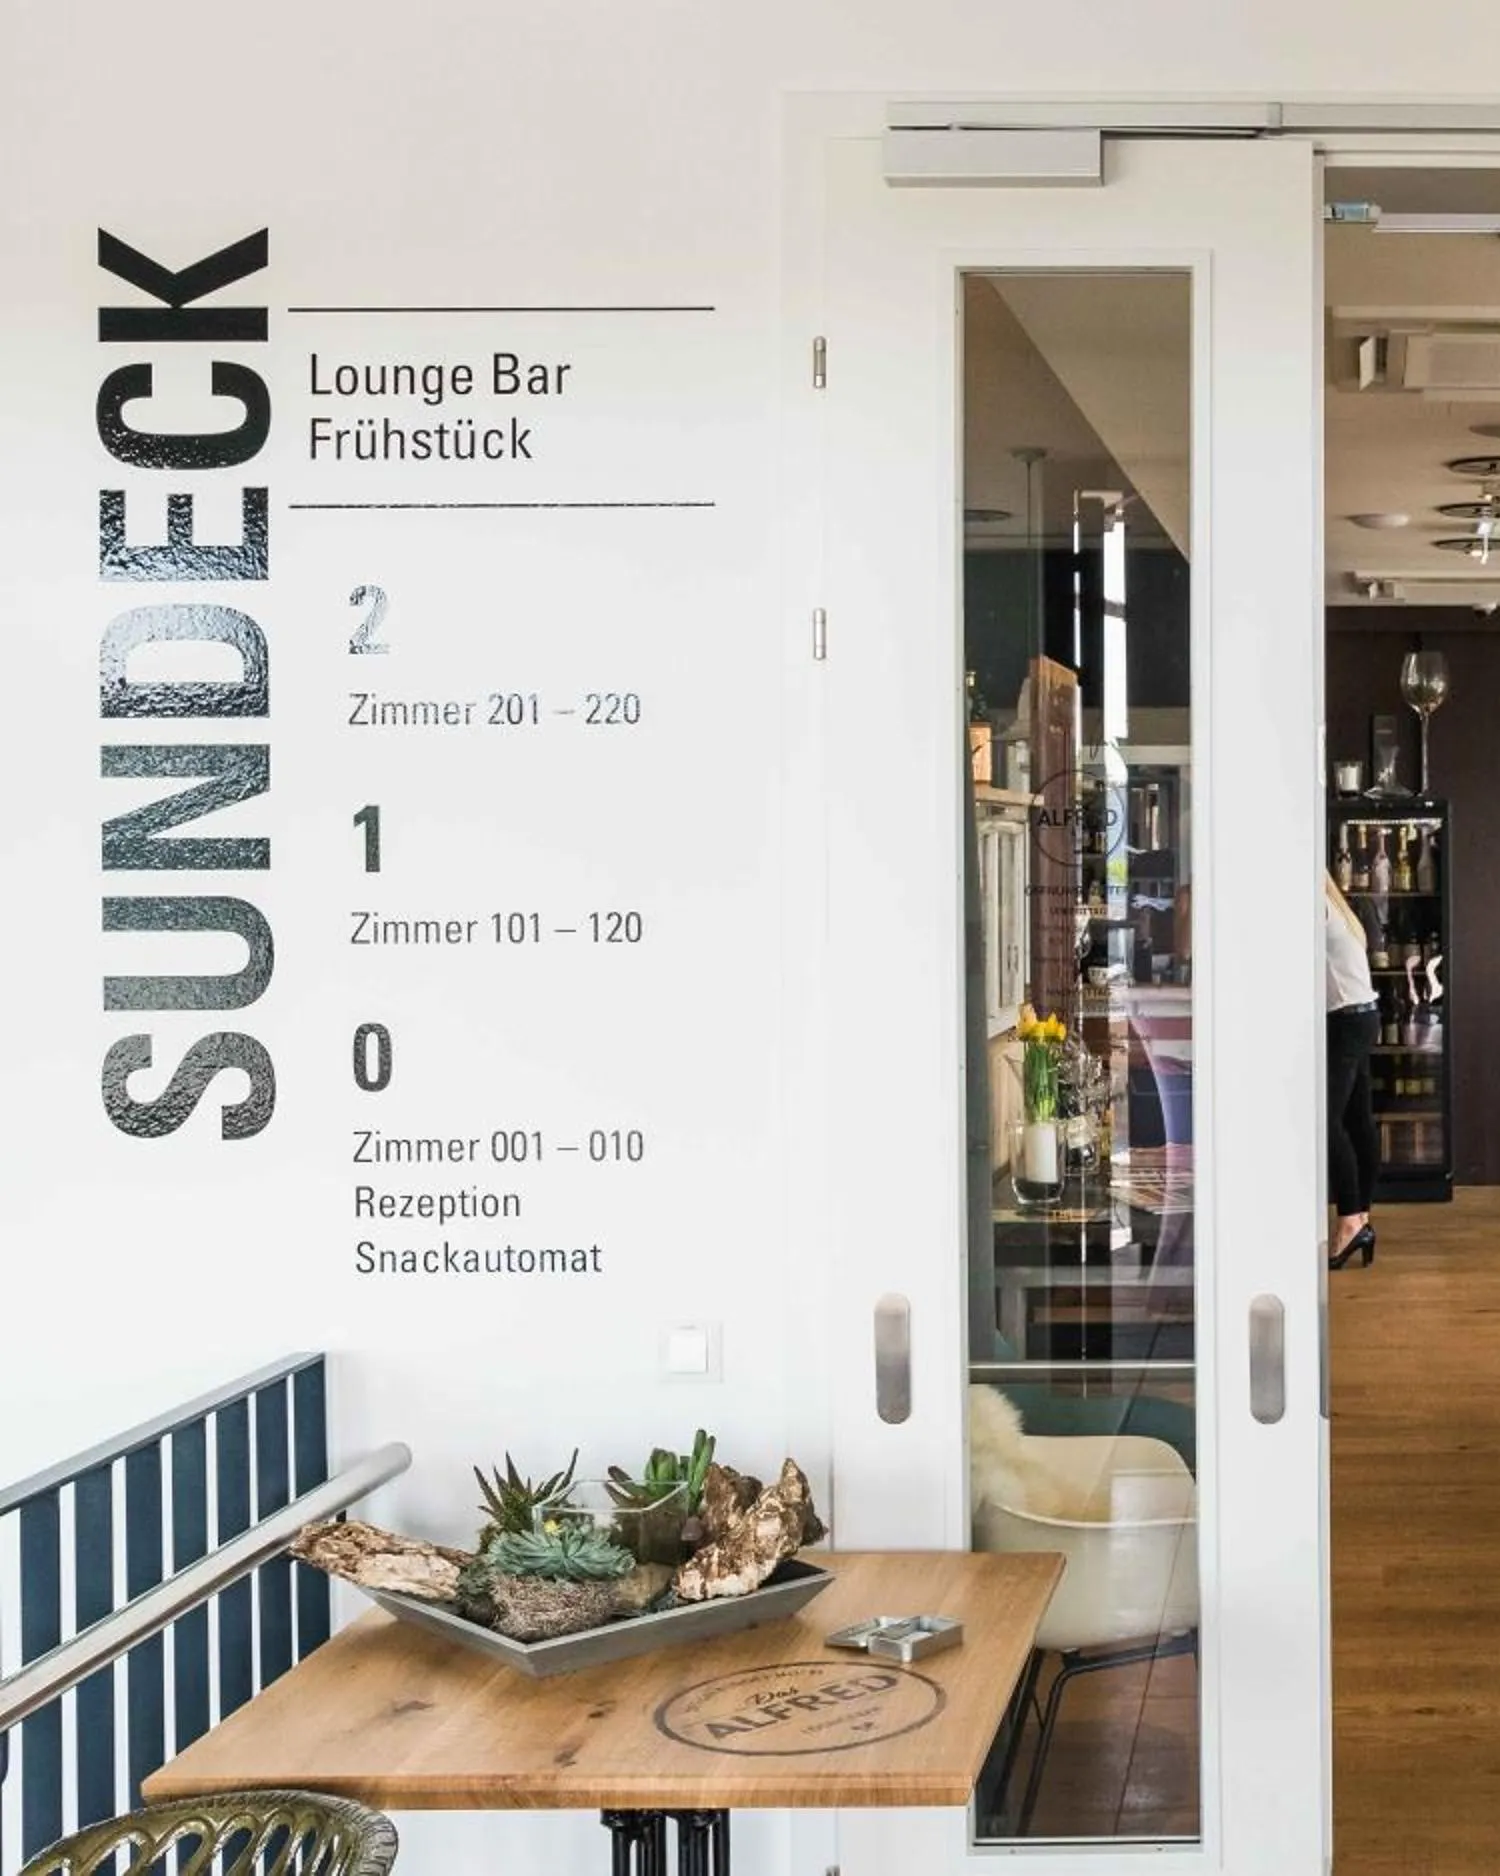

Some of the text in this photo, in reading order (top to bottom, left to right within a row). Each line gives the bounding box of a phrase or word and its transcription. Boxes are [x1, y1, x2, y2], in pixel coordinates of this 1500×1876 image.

[309, 353, 571, 406] Lounge Bar
[309, 416, 533, 461] Frühstück
[348, 585, 391, 655] 2
[97, 227, 276, 1141] SUNDECK
[347, 692, 476, 727] Zimmer
[486, 692, 540, 726] 201
[585, 692, 641, 726] 220
[352, 805, 381, 873] 1
[1037, 808, 1118, 827] ALFRD
[350, 911, 478, 946] Zimmer
[491, 911, 540, 945] 101
[588, 911, 643, 945] 120
[352, 1023, 393, 1093] 0
[352, 1130, 480, 1164] Zimmer
[490, 1130, 543, 1163] 001
[588, 1130, 645, 1163] 010
[354, 1185, 521, 1226] Rezeption
[355, 1240, 603, 1275] Snackautomat
[704, 1674, 899, 1741] ALFRED
